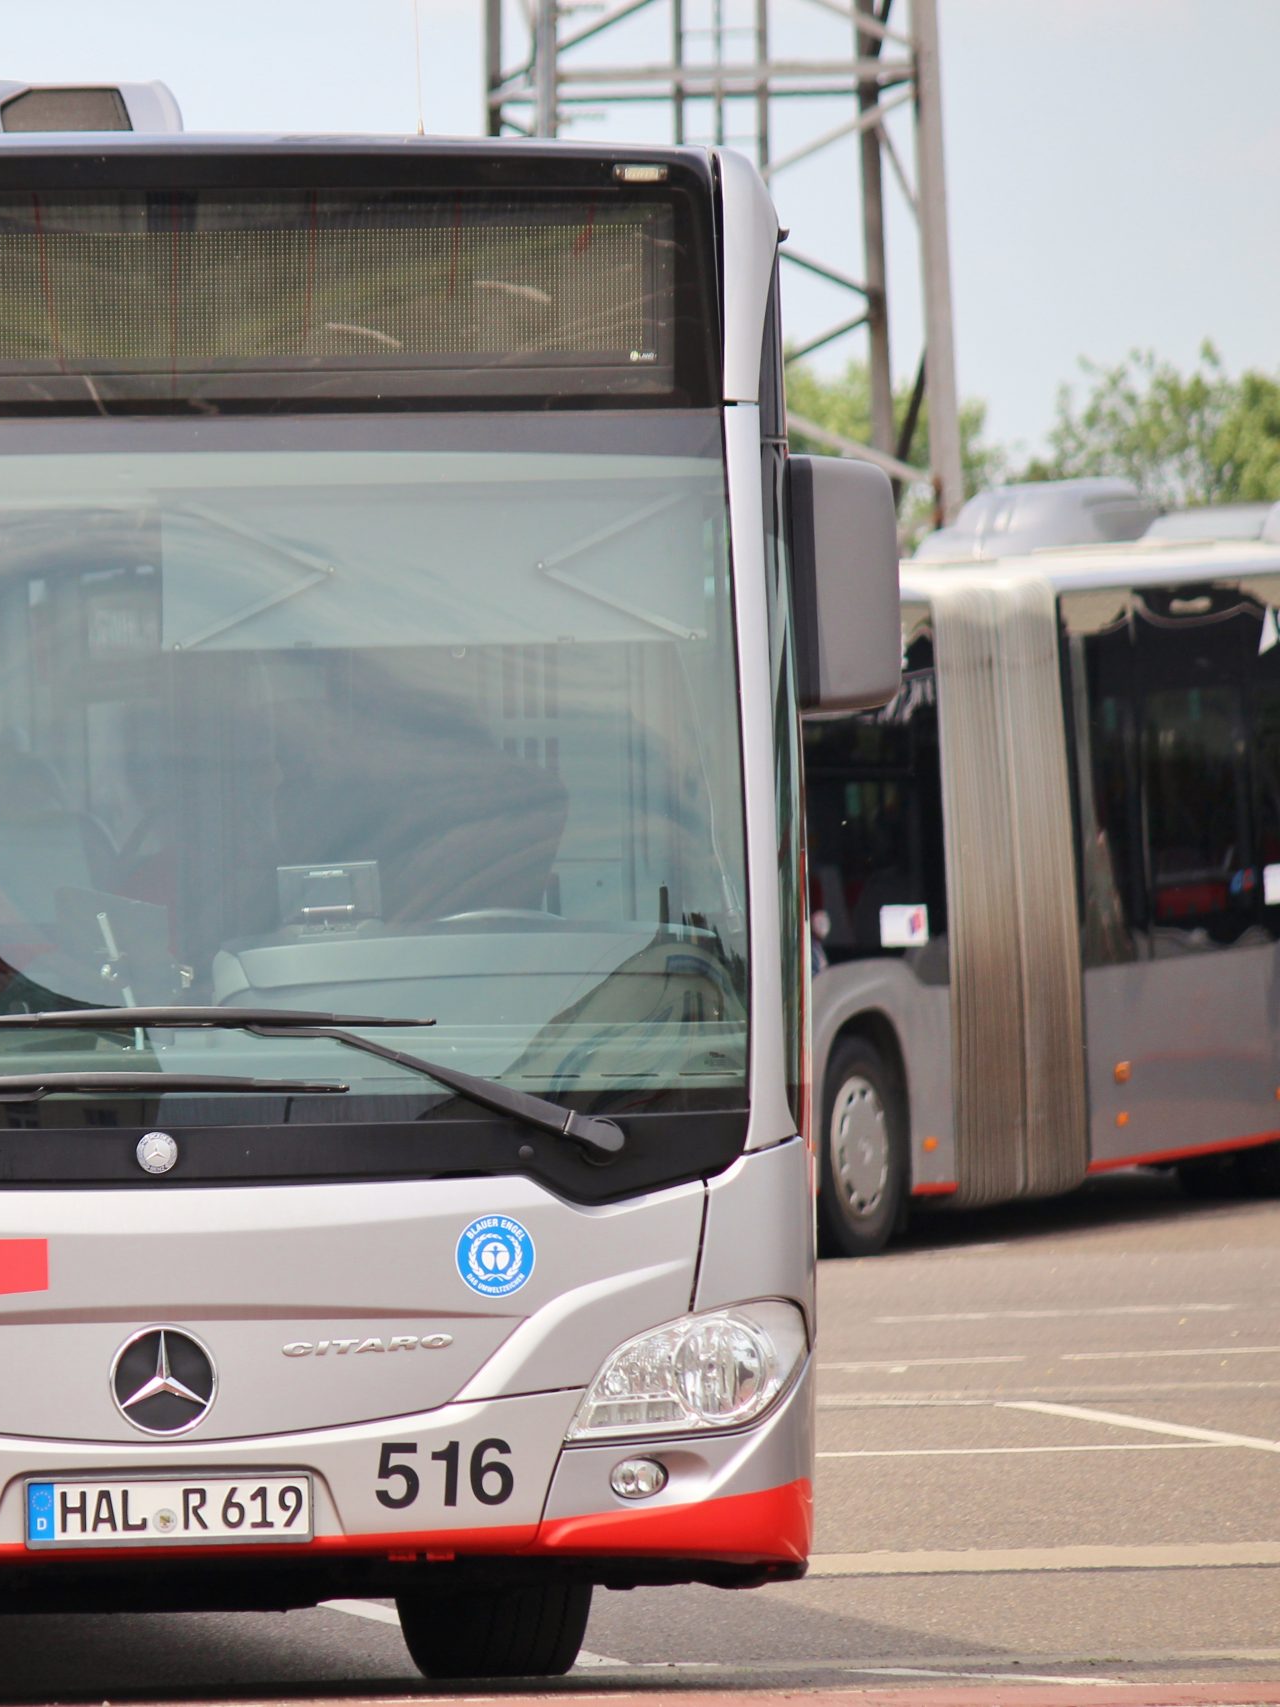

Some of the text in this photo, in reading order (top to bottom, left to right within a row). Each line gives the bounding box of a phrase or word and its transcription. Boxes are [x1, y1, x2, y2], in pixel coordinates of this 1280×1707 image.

[465, 1218, 526, 1242] BLAUER ENGEL
[281, 1333, 454, 1358] CITARO
[375, 1438, 514, 1509] 516
[36, 1485, 303, 1533] D HAL R 619
